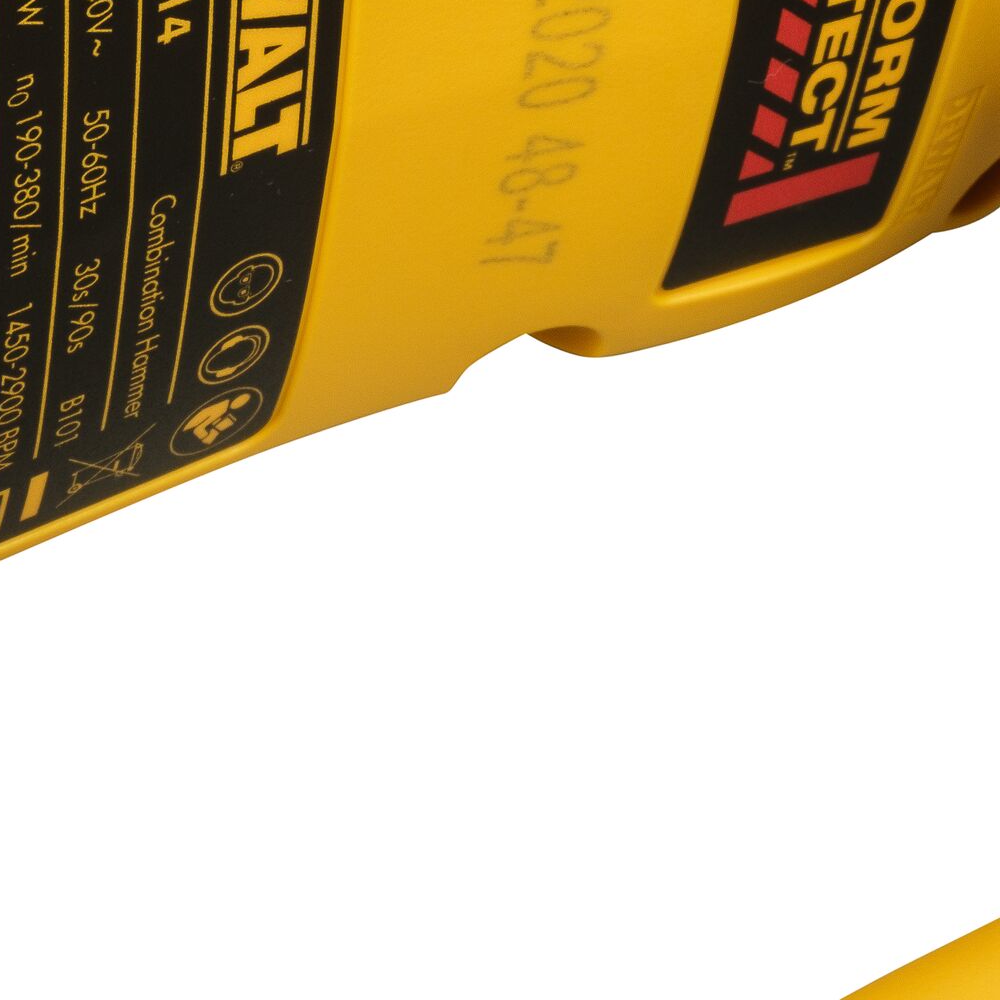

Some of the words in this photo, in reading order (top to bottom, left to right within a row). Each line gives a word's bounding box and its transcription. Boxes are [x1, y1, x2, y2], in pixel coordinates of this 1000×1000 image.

[80, 110, 109, 219] 50-60Hz
[479, 134, 586, 265] 48-47
[67, 259, 100, 353] 30s/90s
[138, 195, 176, 333] Combination
[54, 394, 85, 447] B101
[125, 335, 158, 417] Hammer
